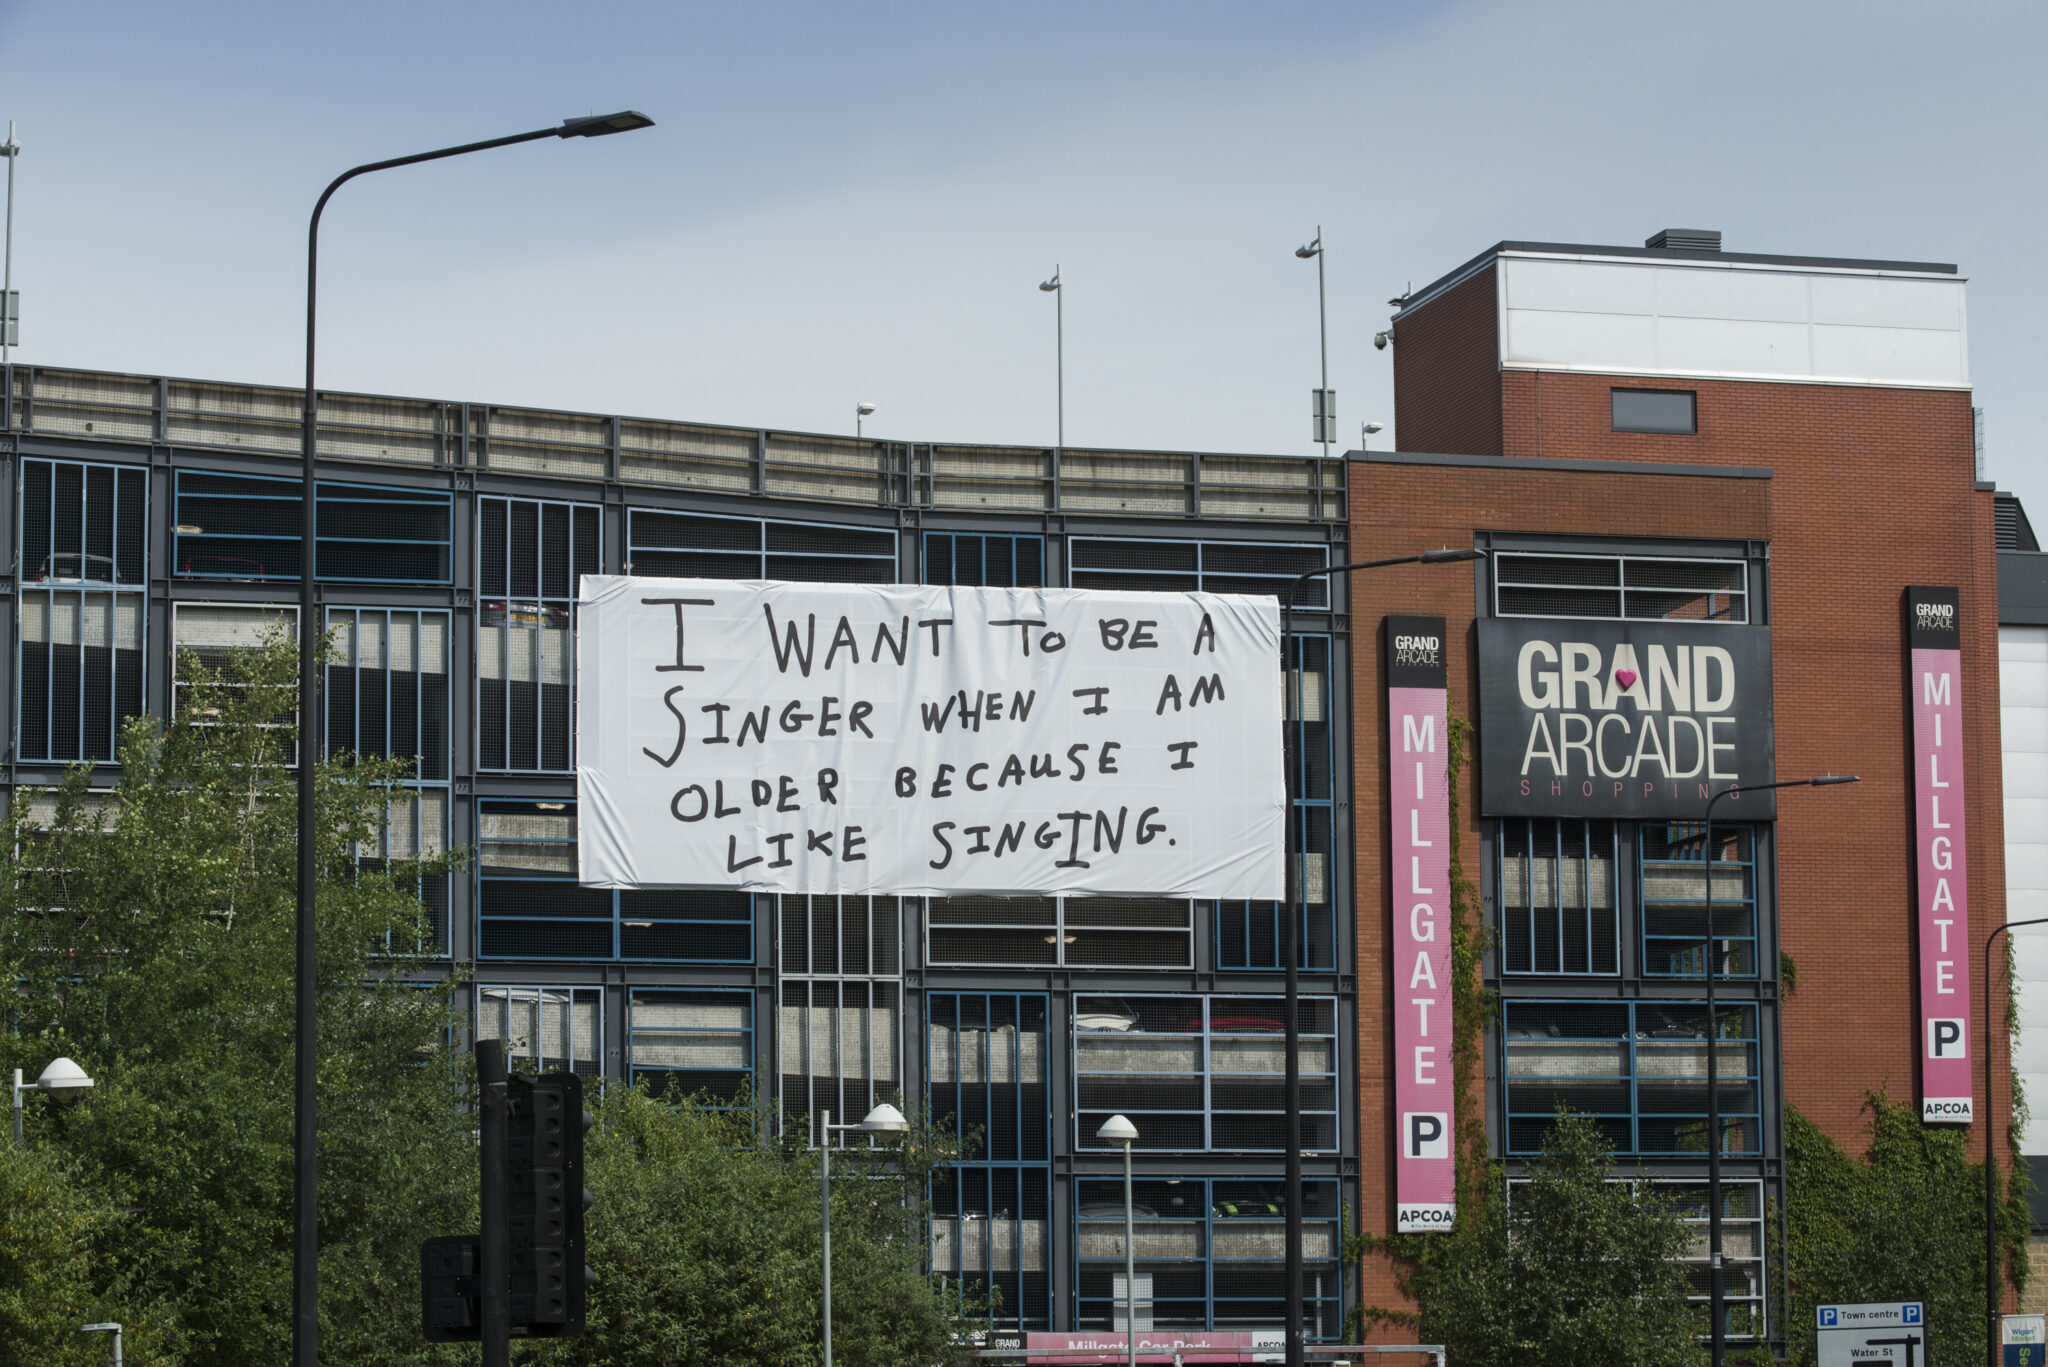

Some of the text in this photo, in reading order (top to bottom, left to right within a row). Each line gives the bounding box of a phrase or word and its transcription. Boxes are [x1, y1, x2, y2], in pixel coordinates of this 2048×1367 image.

[1916, 603, 1953, 617] GRAND
[1917, 616, 1954, 628] ARCADE
[641, 598, 715, 672] I
[764, 602, 954, 678] WANT
[1099, 618, 1159, 651] BE
[1193, 613, 1215, 656] A
[1395, 635, 1439, 650] GRAND
[1396, 649, 1439, 664] ARCADE
[1517, 640, 1735, 713] GRAND
[643, 674, 1225, 767] SINGER WHEN I AM
[1520, 712, 1739, 780] ARCADE
[670, 741, 1198, 823] OLDER BECAUSE I
[1520, 779, 1740, 800] SHOPPING
[727, 807, 1177, 874] LIKE SINGING.
[1923, 671, 1955, 994] MILLGATE
[1403, 714, 1437, 1084] MILLGATE
[1934, 1021, 1960, 1057] P
[1925, 1103, 1970, 1114] APCOA
[1411, 1115, 1442, 1156] P
[1400, 1210, 1453, 1222] APCOA
[1823, 1307, 1917, 1324] P Town centre P
[995, 1339, 1020, 1347] GRAND
[1068, 1341, 1129, 1358] Millgt
[1851, 1348, 1893, 1357] Water St
[2019, 1347, 2031, 1367] Se
